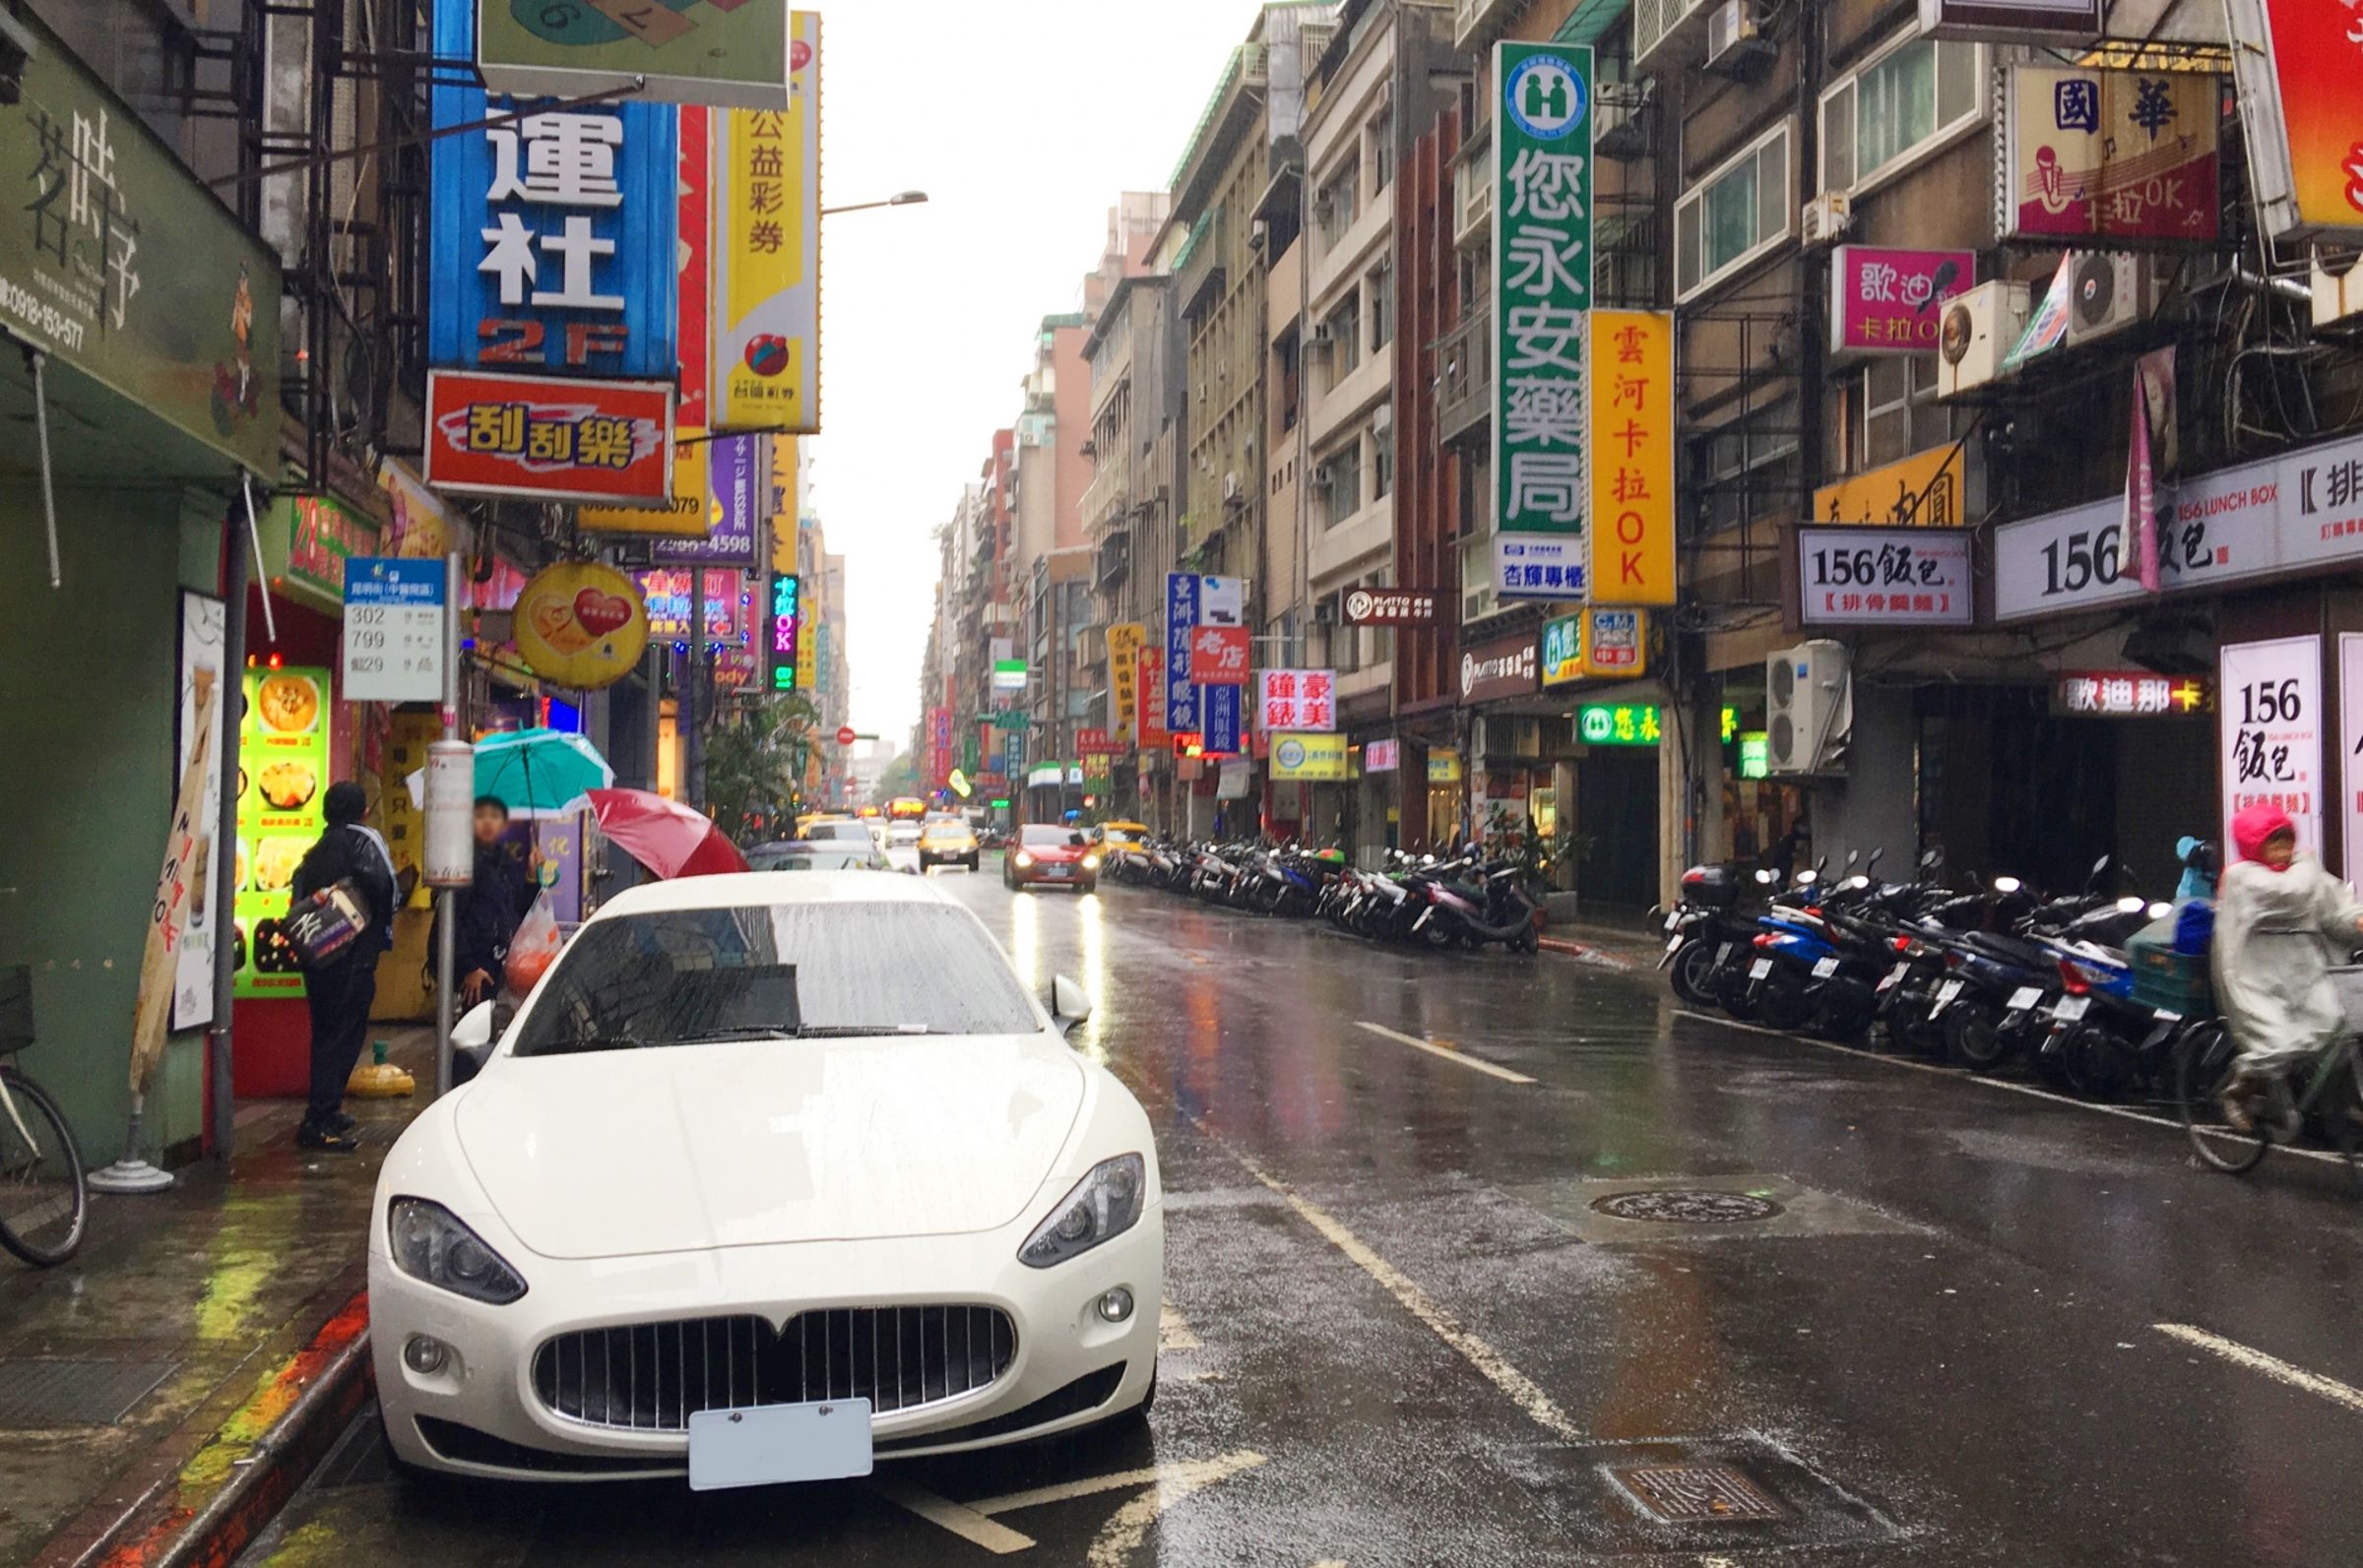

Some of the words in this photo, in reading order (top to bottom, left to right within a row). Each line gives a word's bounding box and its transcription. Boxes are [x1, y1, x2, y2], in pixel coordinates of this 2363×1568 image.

[2055, 78, 2178, 142] 國華
[478, 89, 625, 310] 運社
[748, 108, 785, 255] 公益彩券
[478, 319, 628, 365] 2F
[1505, 148, 1586, 524] 您永安藥局
[467, 402, 633, 470] 刮刮樂
[1612, 325, 1651, 586] 雲河卡拉OK
[2178, 500, 2203, 522] 156
[2205, 490, 2246, 517] LUNCH
[2251, 482, 2277, 506] BOX
[1812, 542, 1945, 588] 156飯包
[351, 606, 385, 625] 302
[1195, 629, 1245, 668] 老店
[1266, 672, 1296, 727] 鐘錶
[1302, 673, 1331, 727] 豪美
[2067, 677, 2170, 713] 歌迪那
[2240, 678, 2301, 724] 156
[2232, 727, 2295, 784] 飯包
